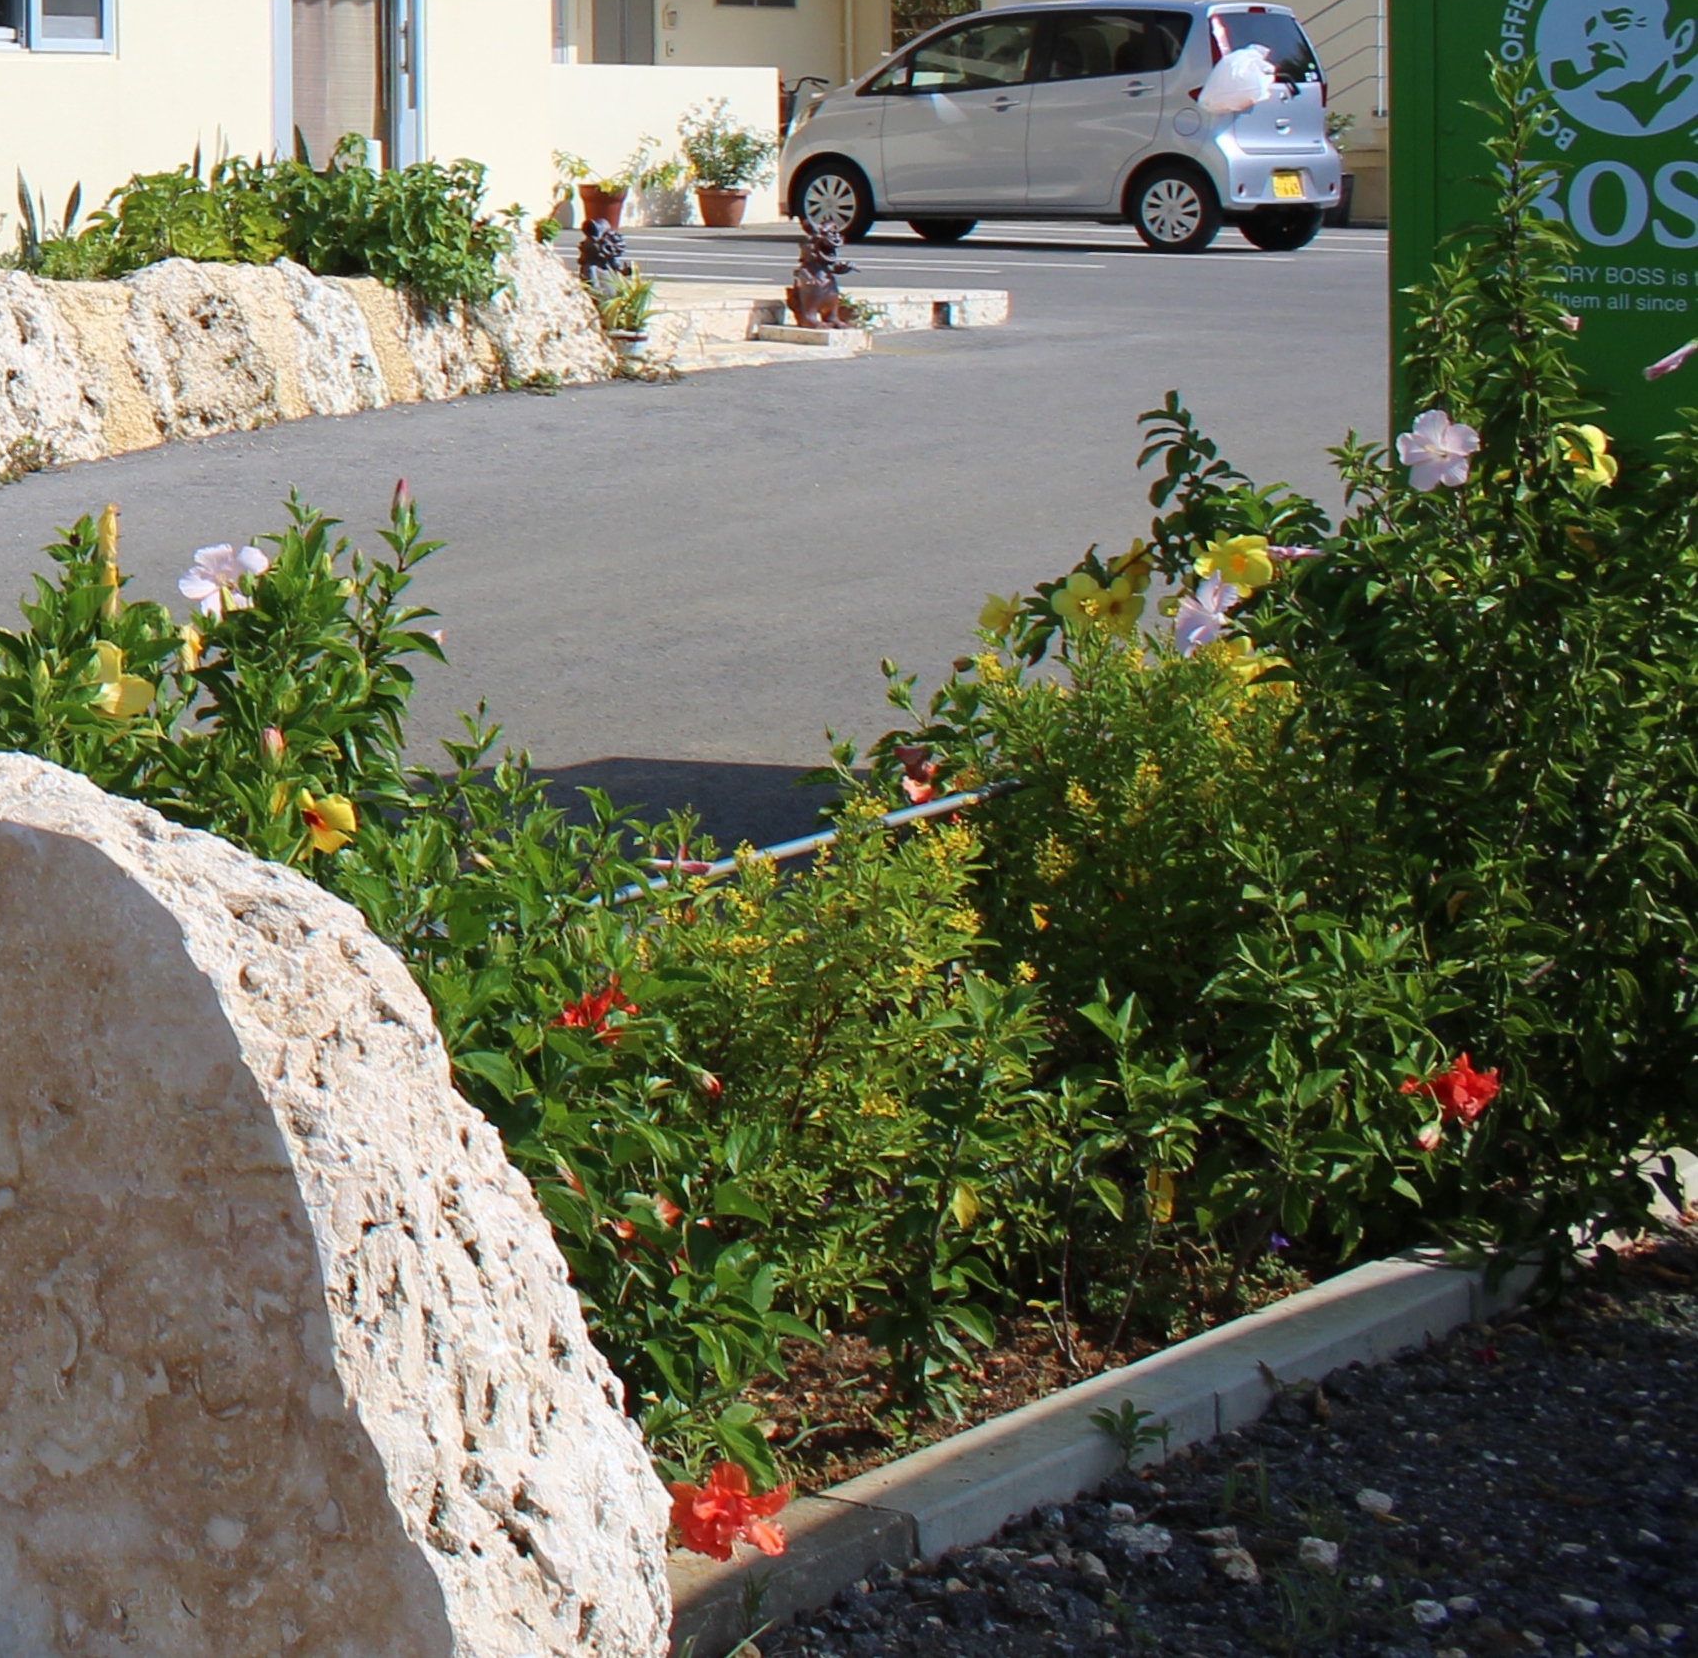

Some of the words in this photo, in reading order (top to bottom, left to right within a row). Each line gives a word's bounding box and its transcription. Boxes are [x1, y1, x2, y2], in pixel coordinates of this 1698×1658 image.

[1605, 266, 1666, 286] BOSS
[1671, 268, 1688, 287] is
[1607, 293, 1630, 311] all
[1635, 293, 1689, 313] since
